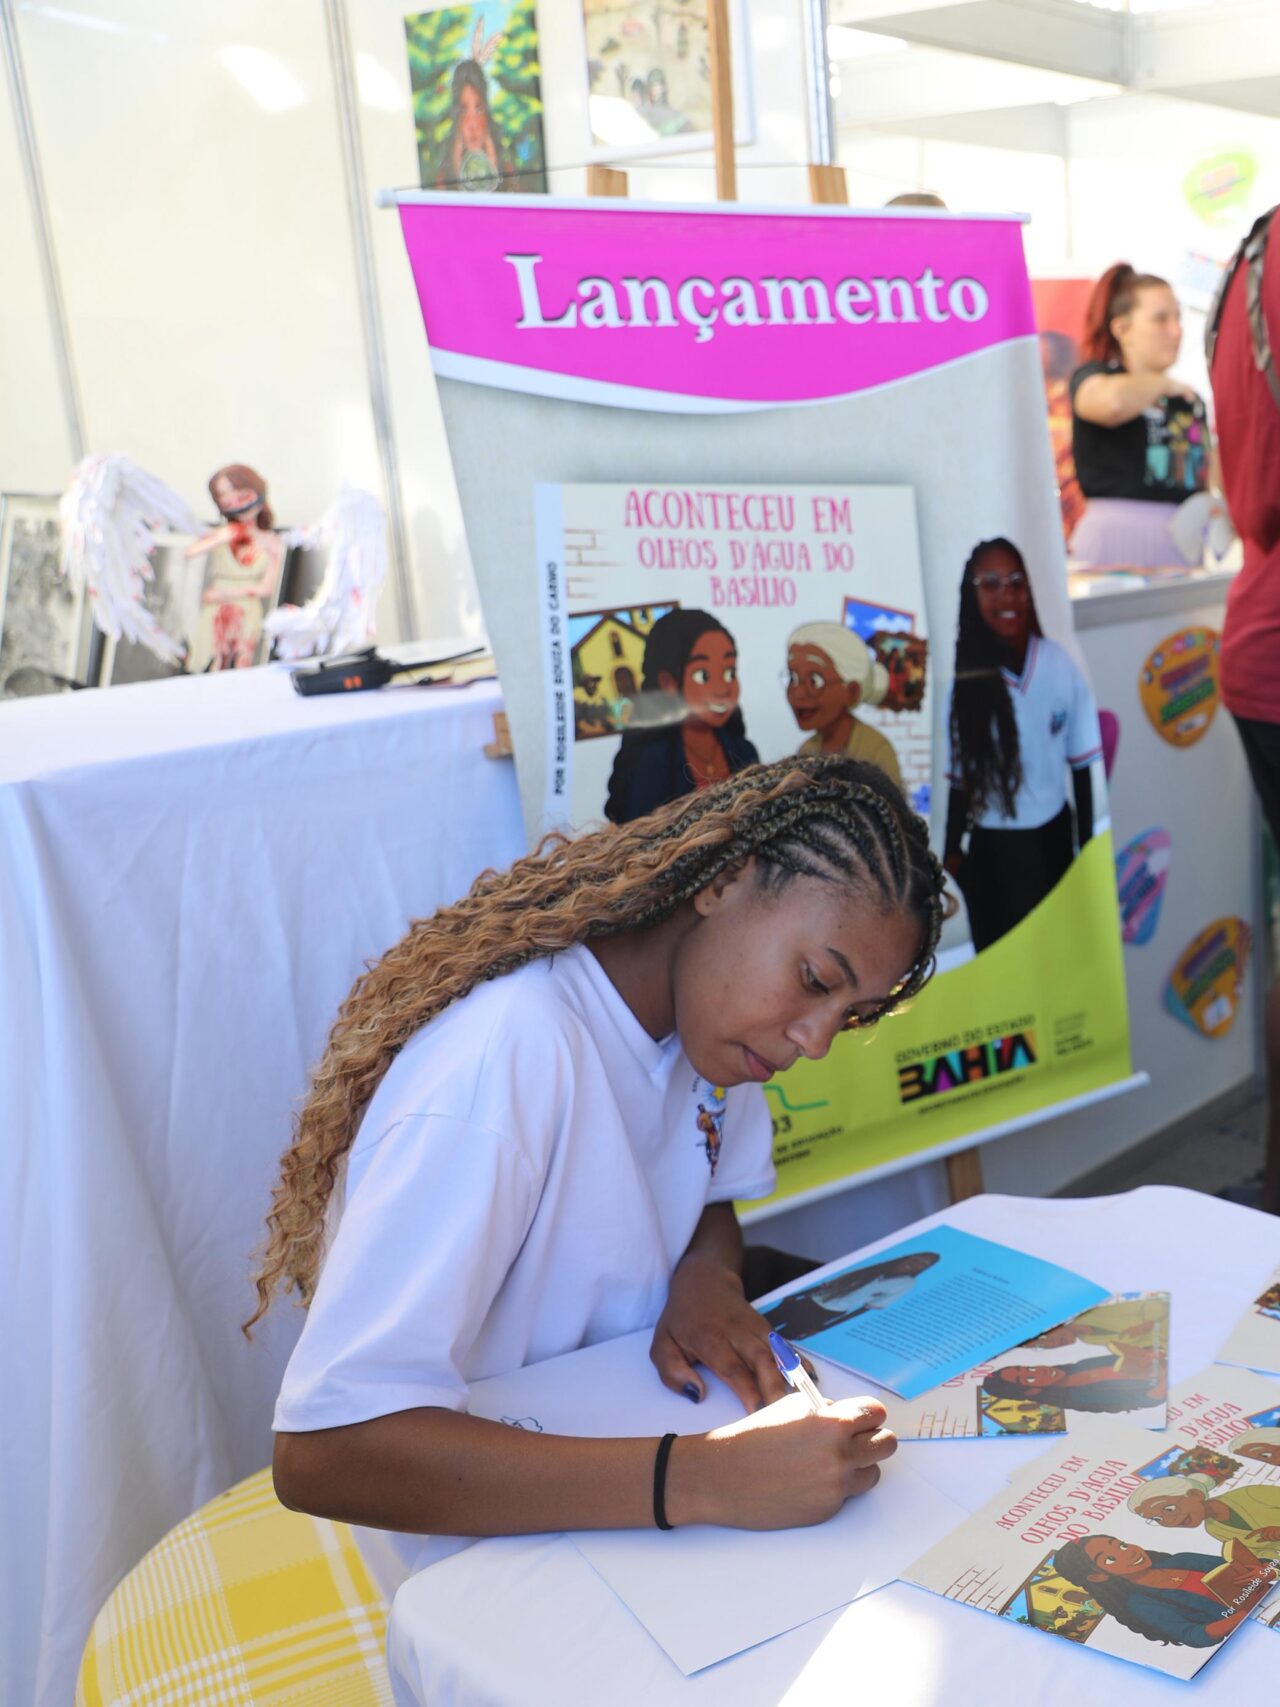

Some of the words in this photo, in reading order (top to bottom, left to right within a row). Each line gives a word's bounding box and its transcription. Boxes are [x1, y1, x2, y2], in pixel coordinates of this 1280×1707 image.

[503, 252, 990, 343] Lançamento
[624, 489, 795, 533] ACONTECEU
[811, 497, 853, 534] EM
[638, 537, 718, 571] OLHOS
[822, 542, 855, 572] DO
[547, 561, 560, 610] CARMO
[550, 615, 561, 635] DO
[897, 1029, 1037, 1105] BAHIA
[1181, 1393, 1210, 1409] EM
[1197, 1419, 1250, 1449] ASÍLIO
[994, 1473, 1067, 1530] ACONTECEU
[1060, 1455, 1089, 1473] EM
[1020, 1504, 1077, 1545] OLHOS
[1056, 1523, 1090, 1545] DO
[1221, 1605, 1236, 1618] Por
[1233, 1577, 1262, 1605] Rosileide
[1259, 1558, 1280, 1577] Souza
